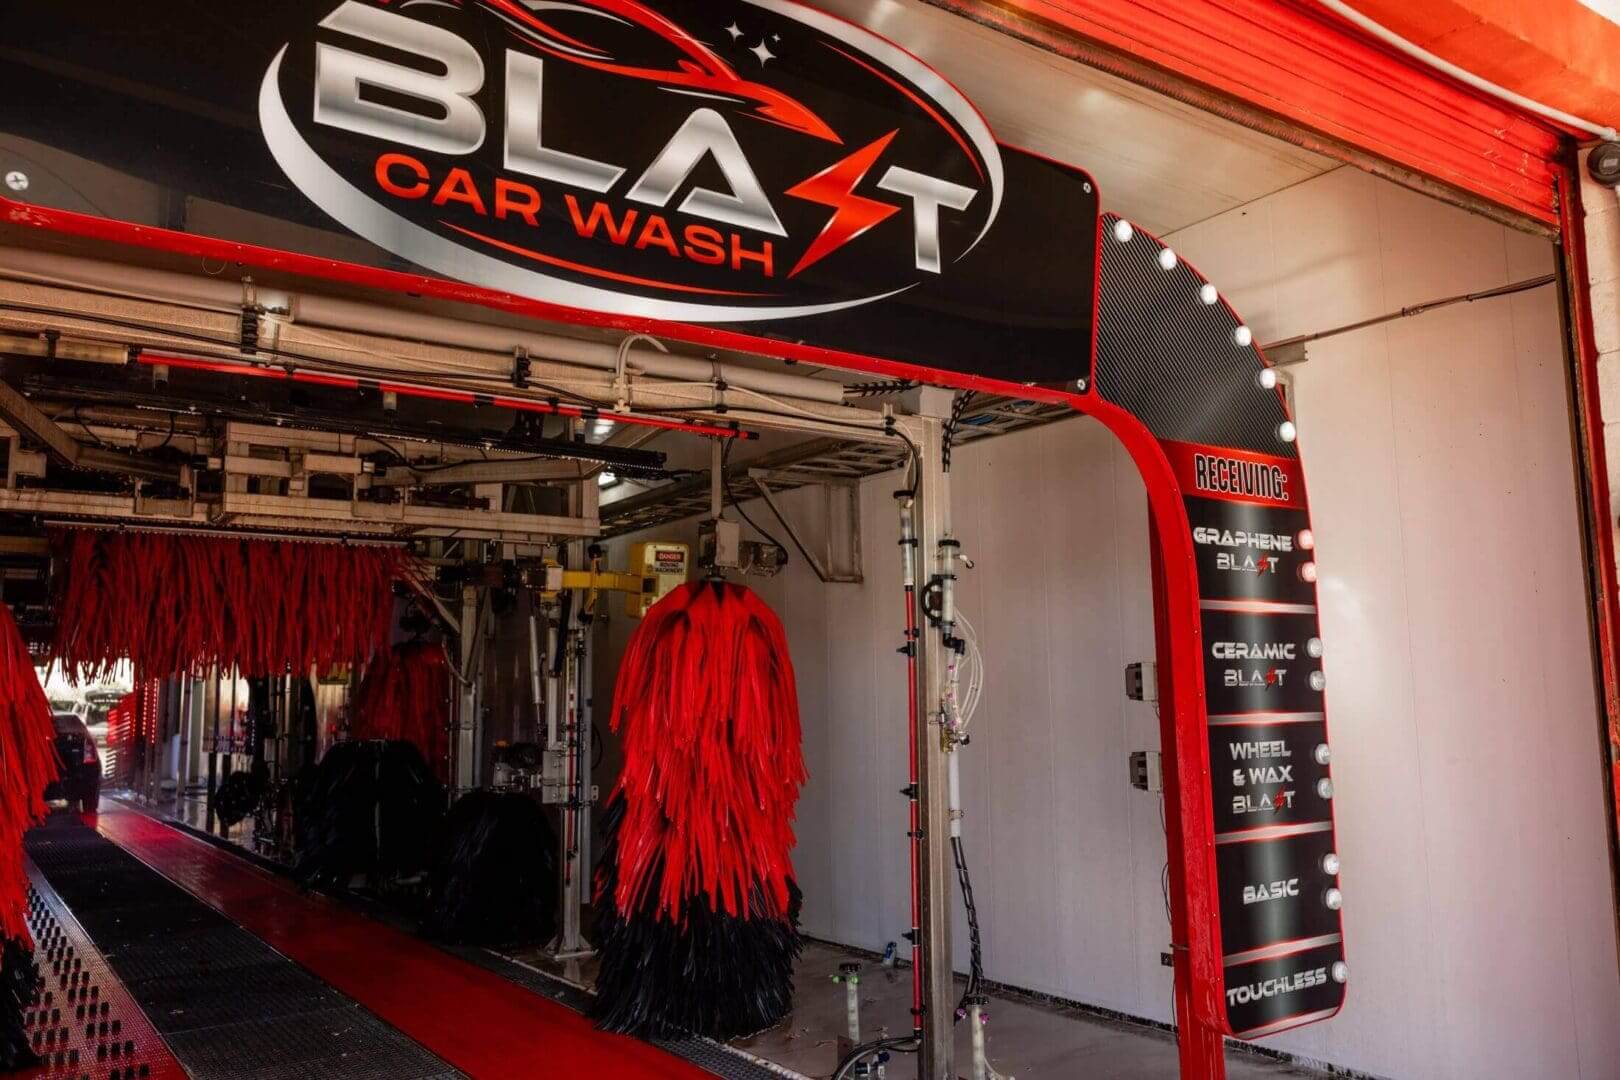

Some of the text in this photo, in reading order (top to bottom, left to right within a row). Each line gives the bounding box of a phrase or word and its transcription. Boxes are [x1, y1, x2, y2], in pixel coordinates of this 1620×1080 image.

[313, 0, 978, 278] BLAST
[374, 152, 775, 278] CAR WASH
[1194, 453, 1289, 501] RECEIVING:
[1193, 526, 1293, 552] GRAPHENE
[658, 552, 682, 560] DANGER
[1211, 641, 1296, 660] CERAMIC
[1229, 740, 1292, 760] WHEEL
[1232, 765, 1294, 786] & WAX
[1243, 878, 1299, 905] BASIC
[1226, 967, 1327, 1007] TOUCHLESS
